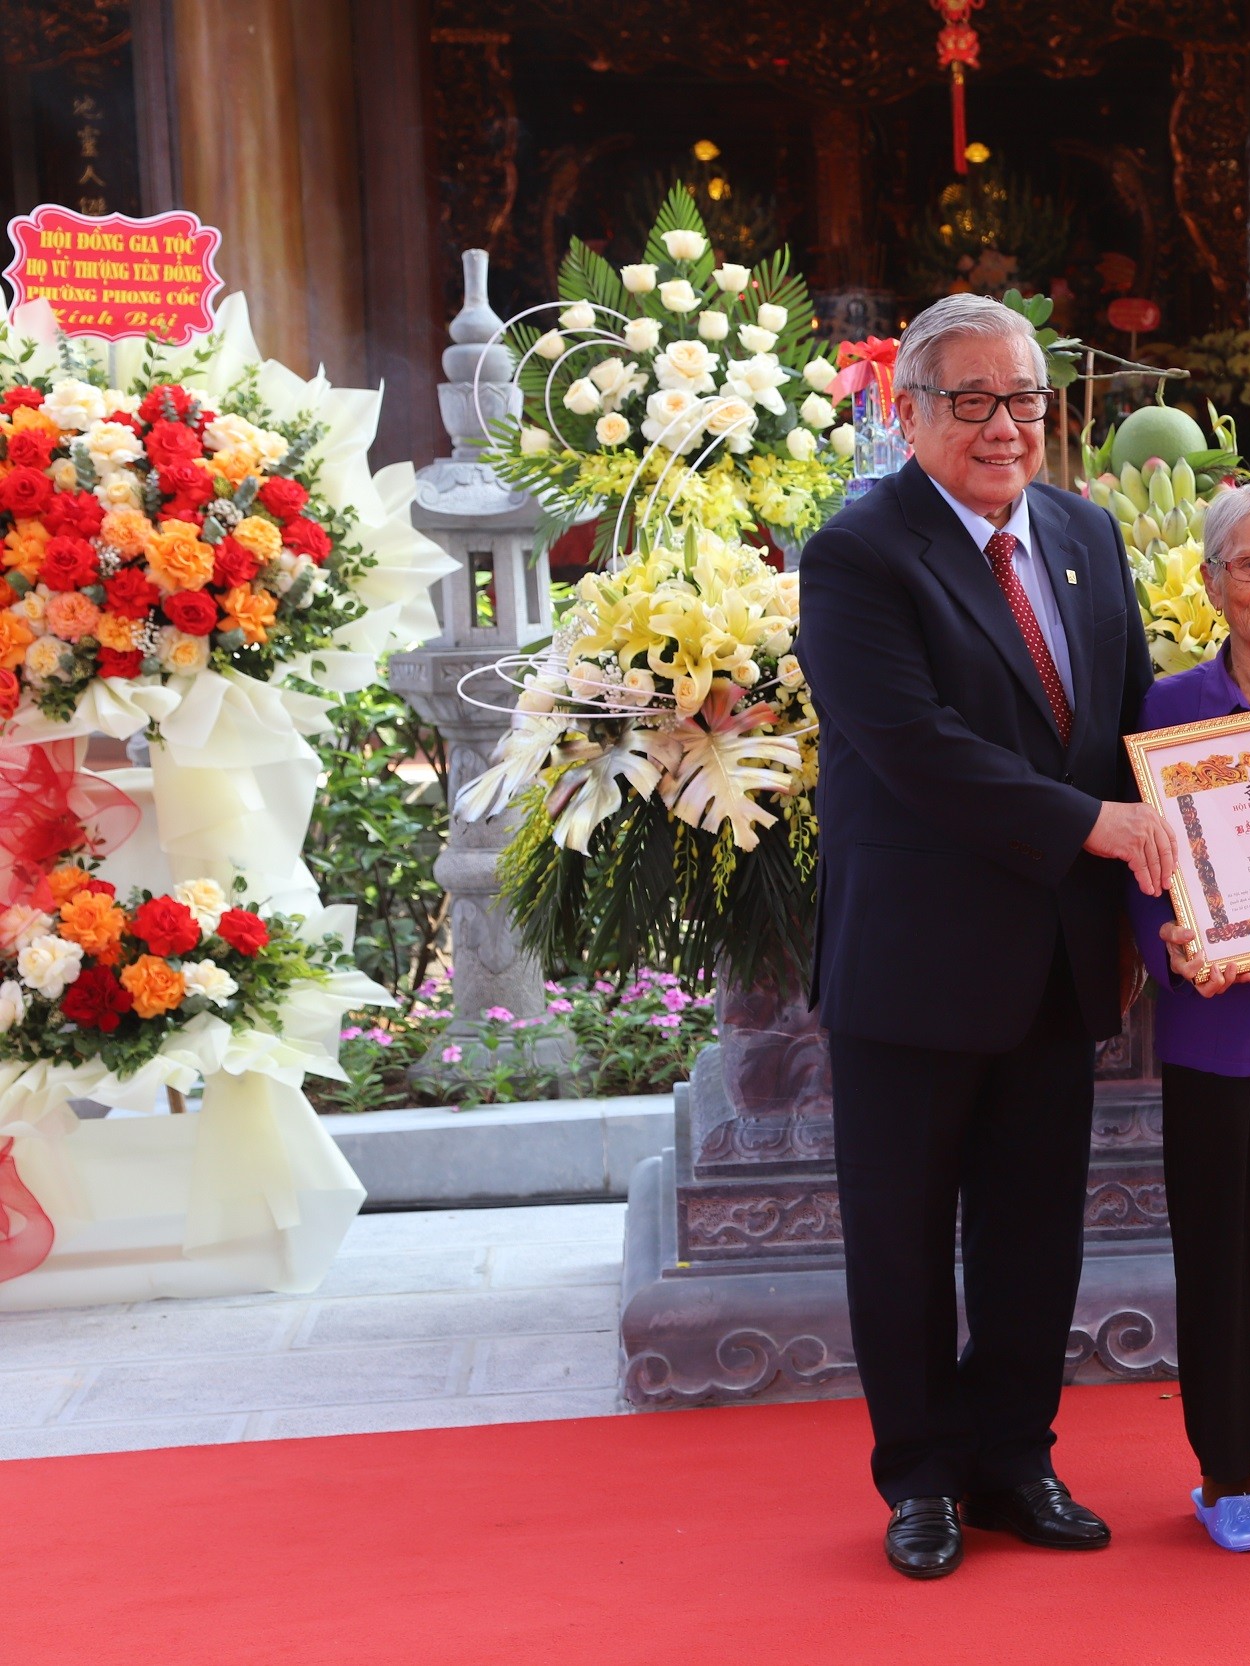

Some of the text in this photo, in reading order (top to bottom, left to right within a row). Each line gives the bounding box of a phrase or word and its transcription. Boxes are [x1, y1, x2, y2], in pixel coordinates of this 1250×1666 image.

[40, 225, 196, 260] HỘI ĐỒNG GIA TỘC
[26, 258, 48, 282] HỌ
[73, 258, 129, 285] THƯỢNG
[133, 258, 160, 282] YÊN
[27, 283, 200, 306] PHƯỜNG PHONG CỐC
[1233, 803, 1247, 811] HỘI
